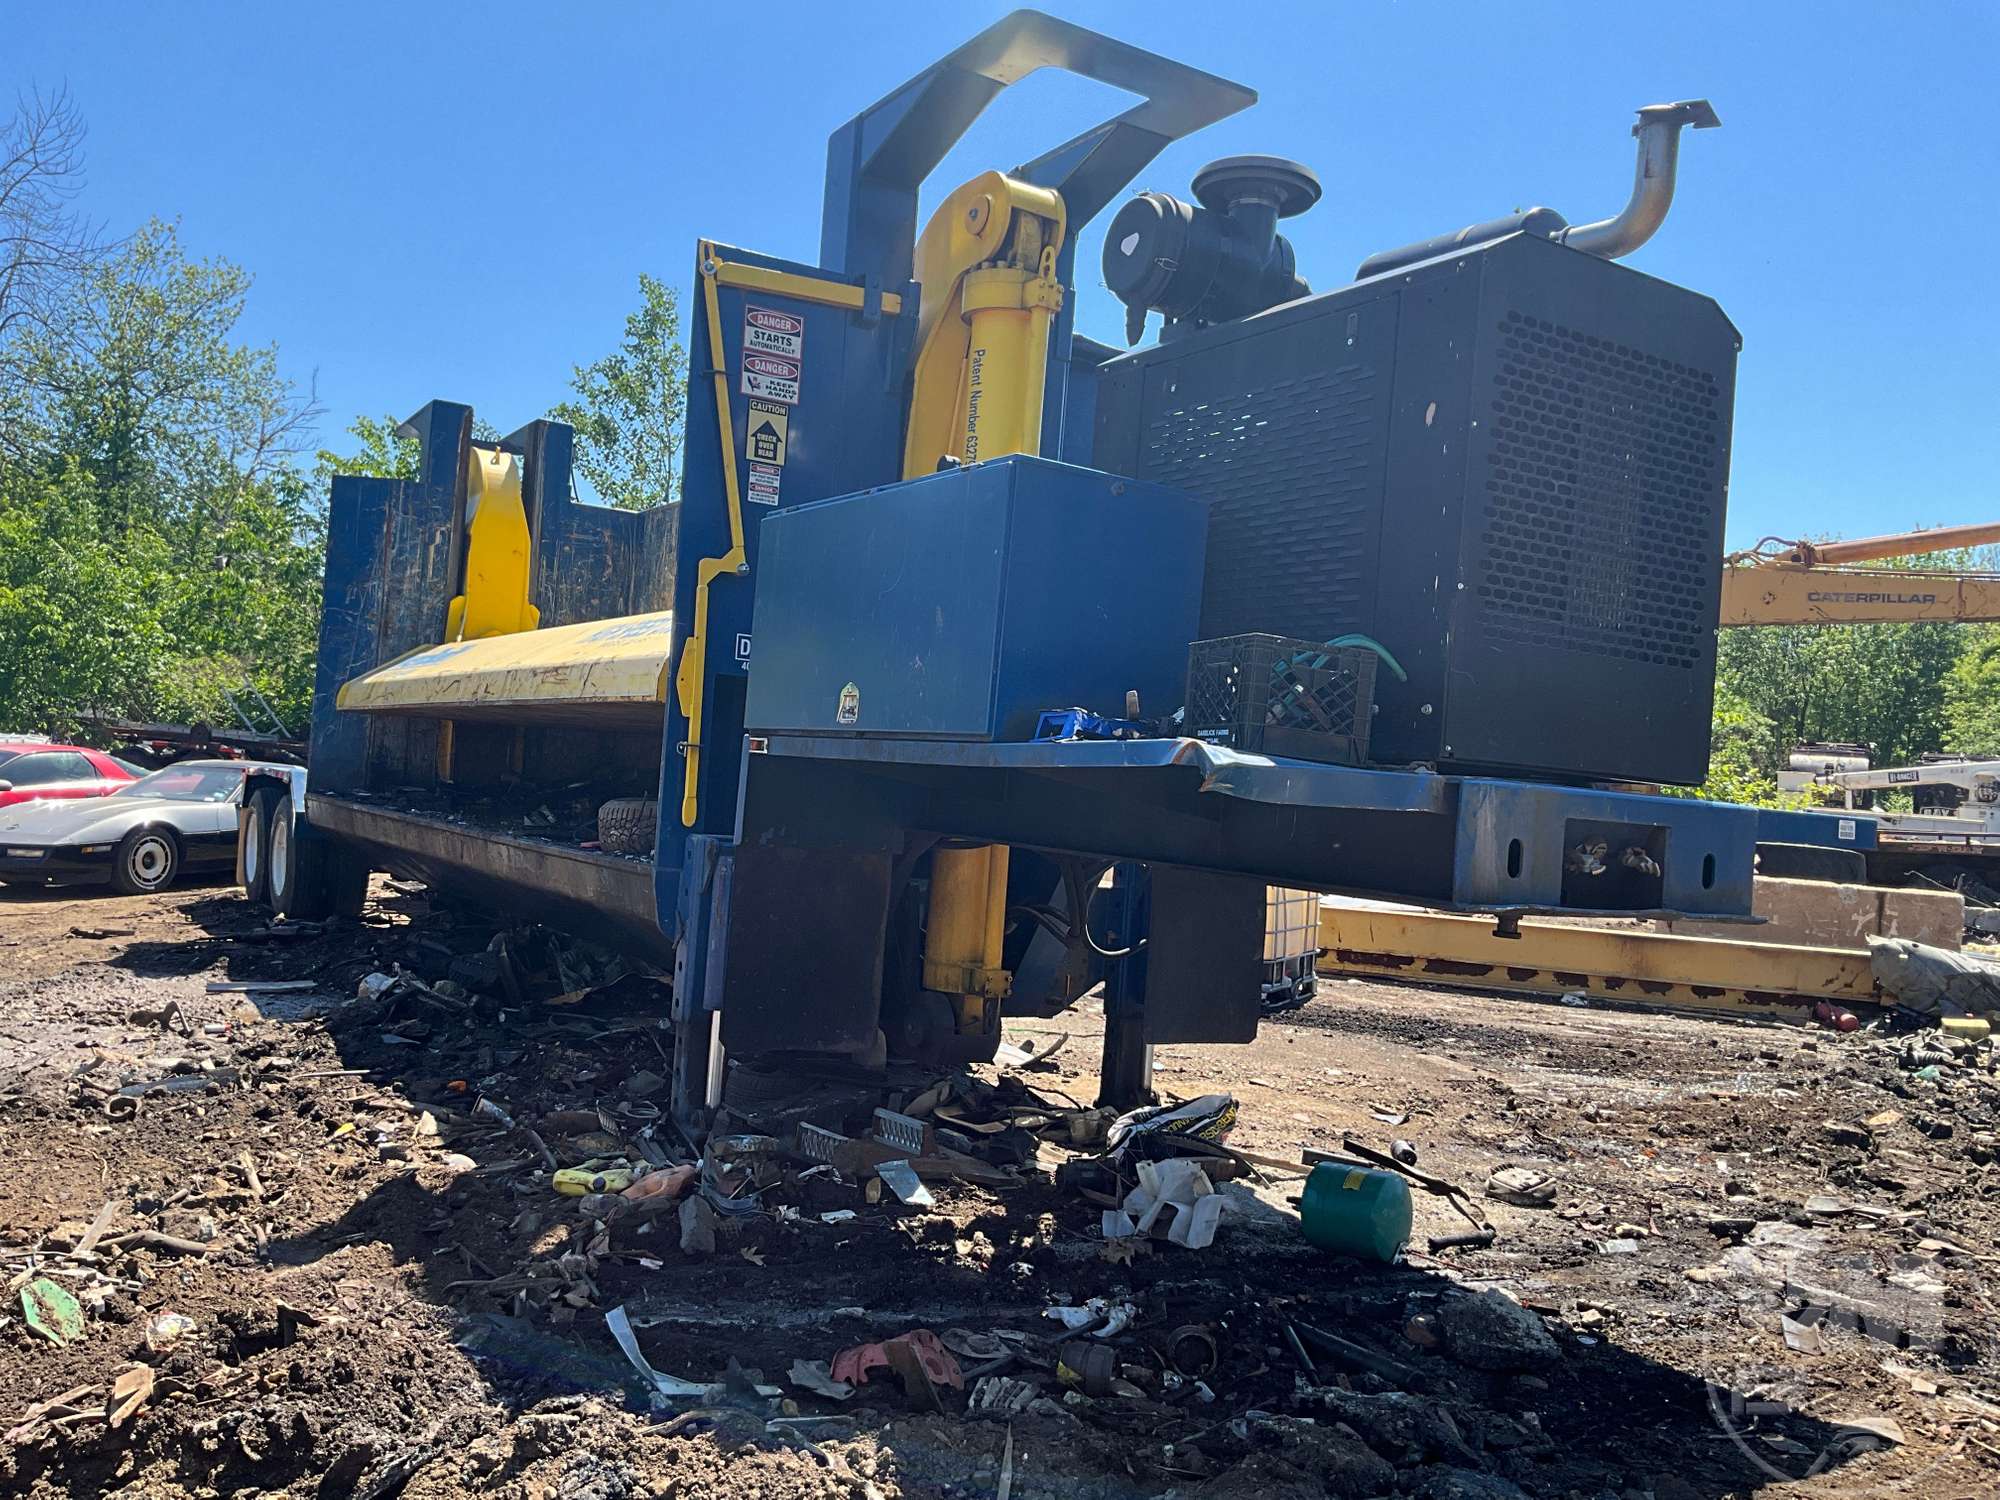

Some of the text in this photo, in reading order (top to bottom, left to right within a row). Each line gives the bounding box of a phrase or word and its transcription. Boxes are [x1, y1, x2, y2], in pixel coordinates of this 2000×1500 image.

[757, 314, 792, 332] DANGER
[753, 330, 793, 347] STARTS
[749, 340, 795, 354] AUTOMATICALLY
[754, 360, 789, 376] DANGER
[971, 349, 985, 386] Patent
[765, 385, 797, 395] HANDS
[770, 380, 794, 389] KEEP
[768, 391, 794, 400] AWAY
[751, 401, 786, 415] CAUTION
[967, 390, 983, 433] Number
[1807, 592, 1937, 604] CATERPILLAR
